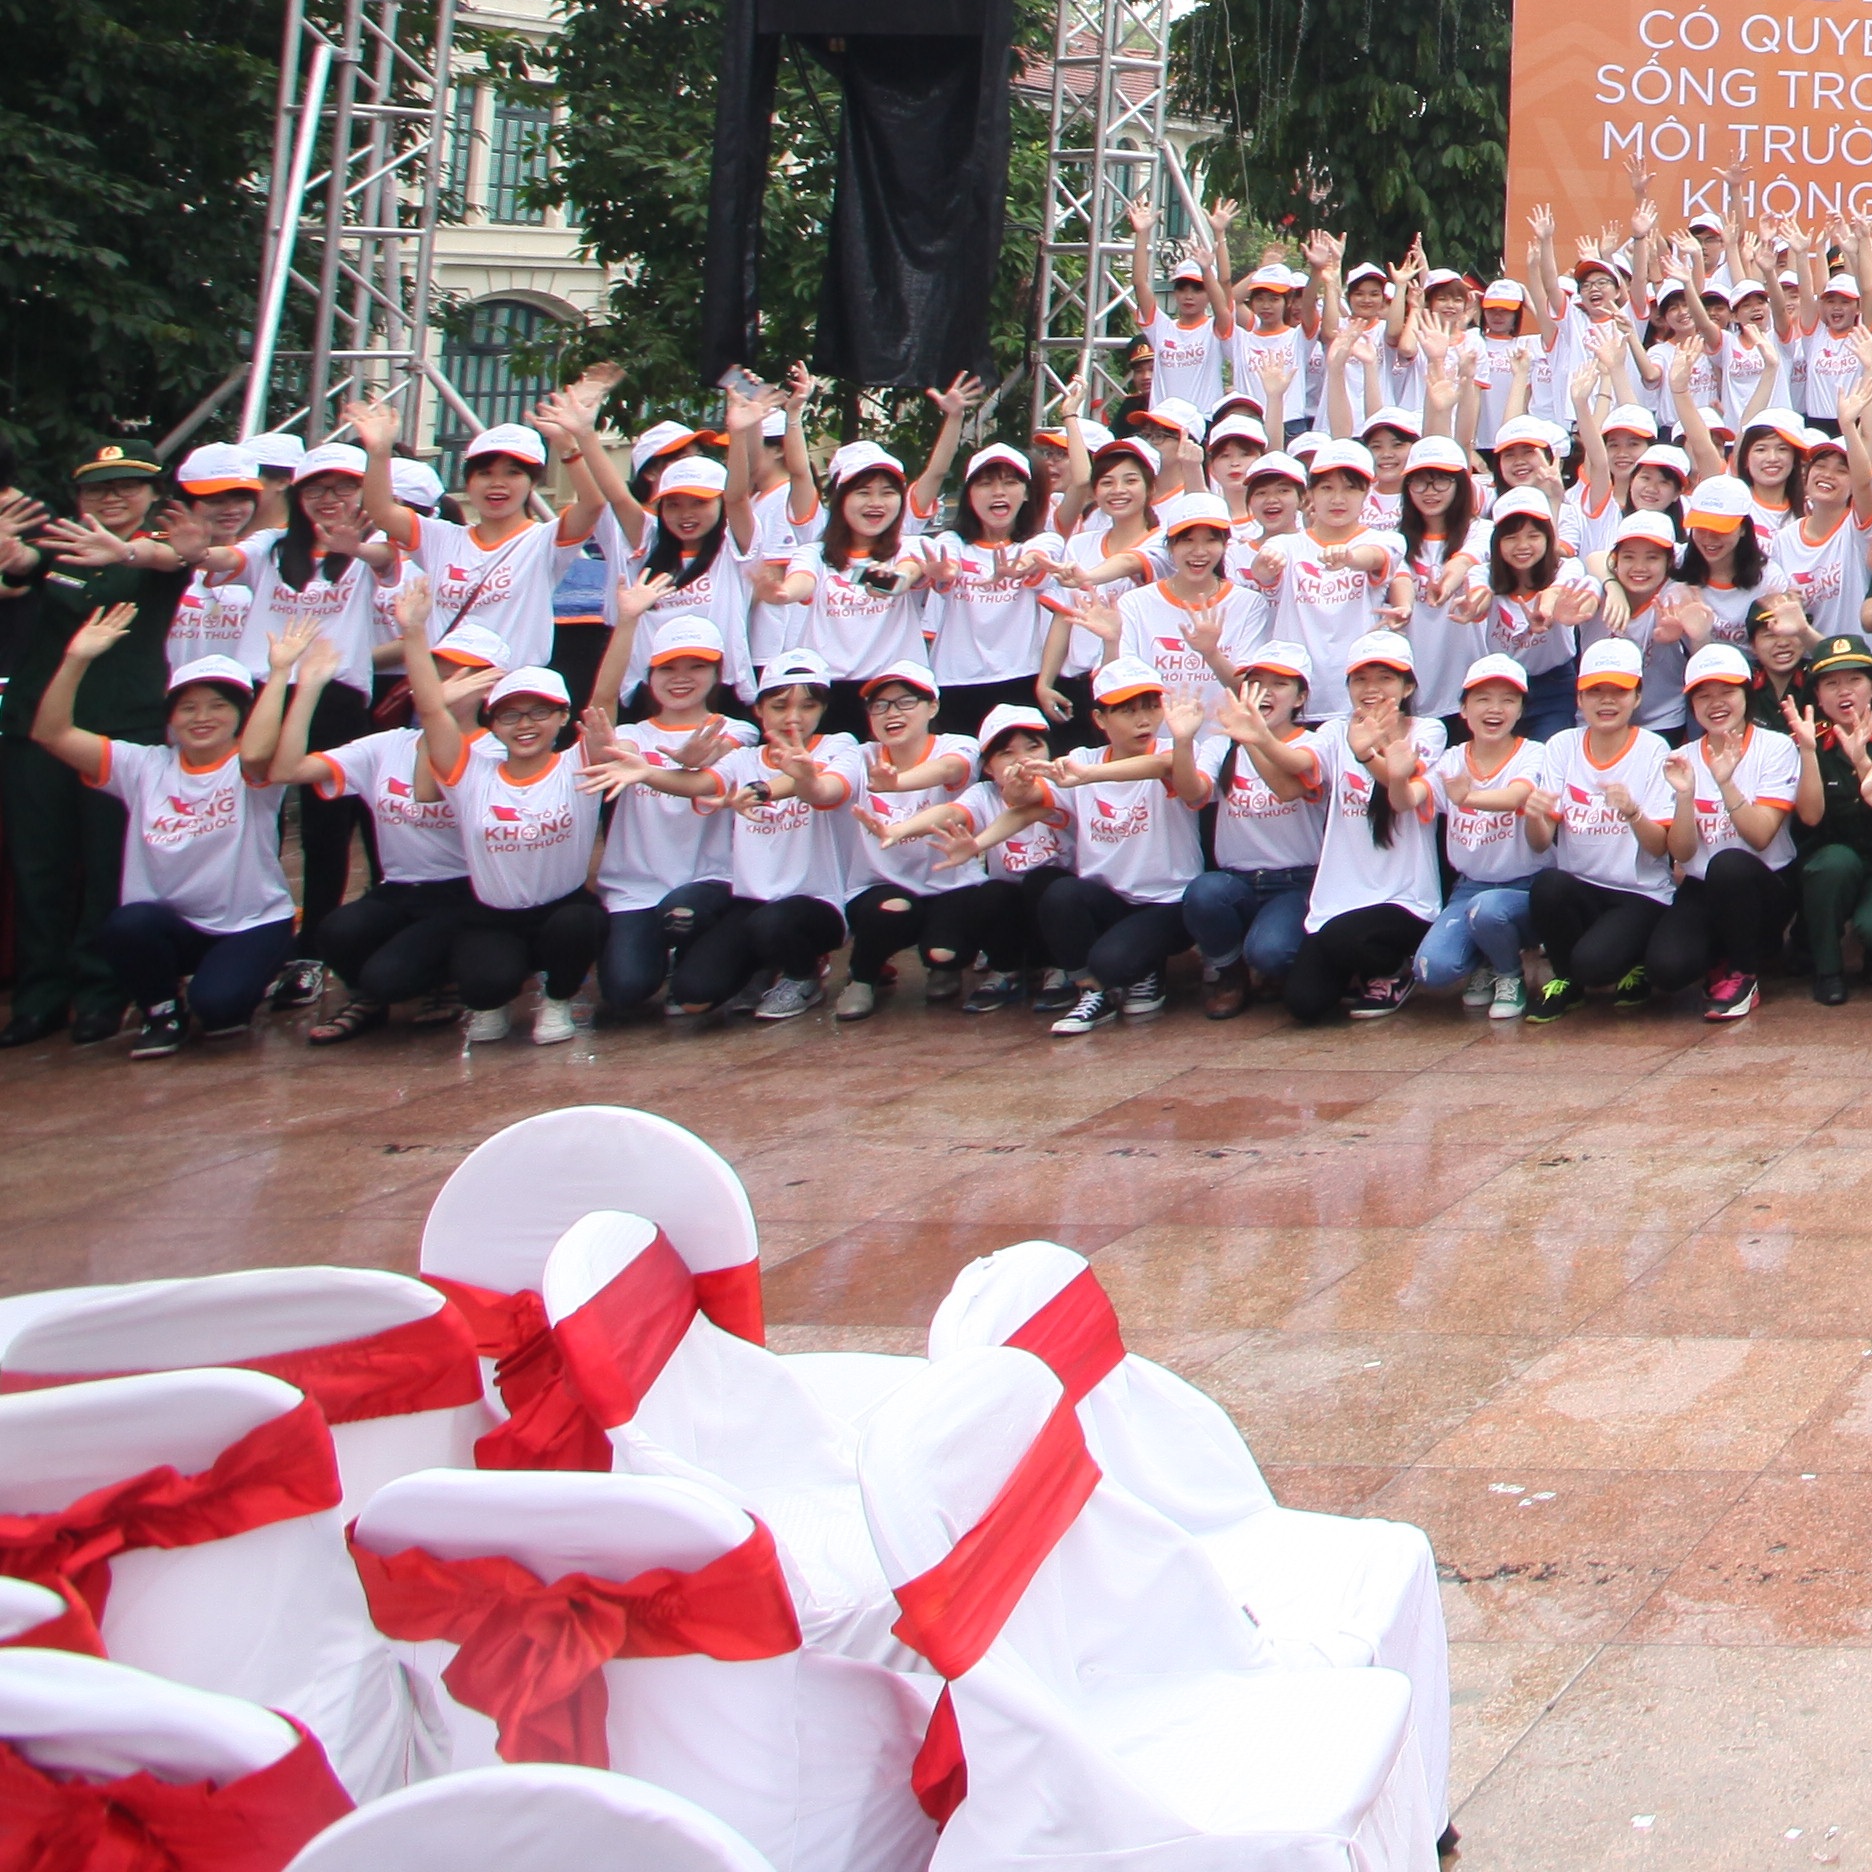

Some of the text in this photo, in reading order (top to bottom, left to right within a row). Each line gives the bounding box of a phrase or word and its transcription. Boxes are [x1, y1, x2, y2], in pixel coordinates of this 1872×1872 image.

[1640, 5, 1719, 50] CÓ
[1596, 52, 1756, 107] SỐNG
[1604, 115, 1704, 161] MÔI
